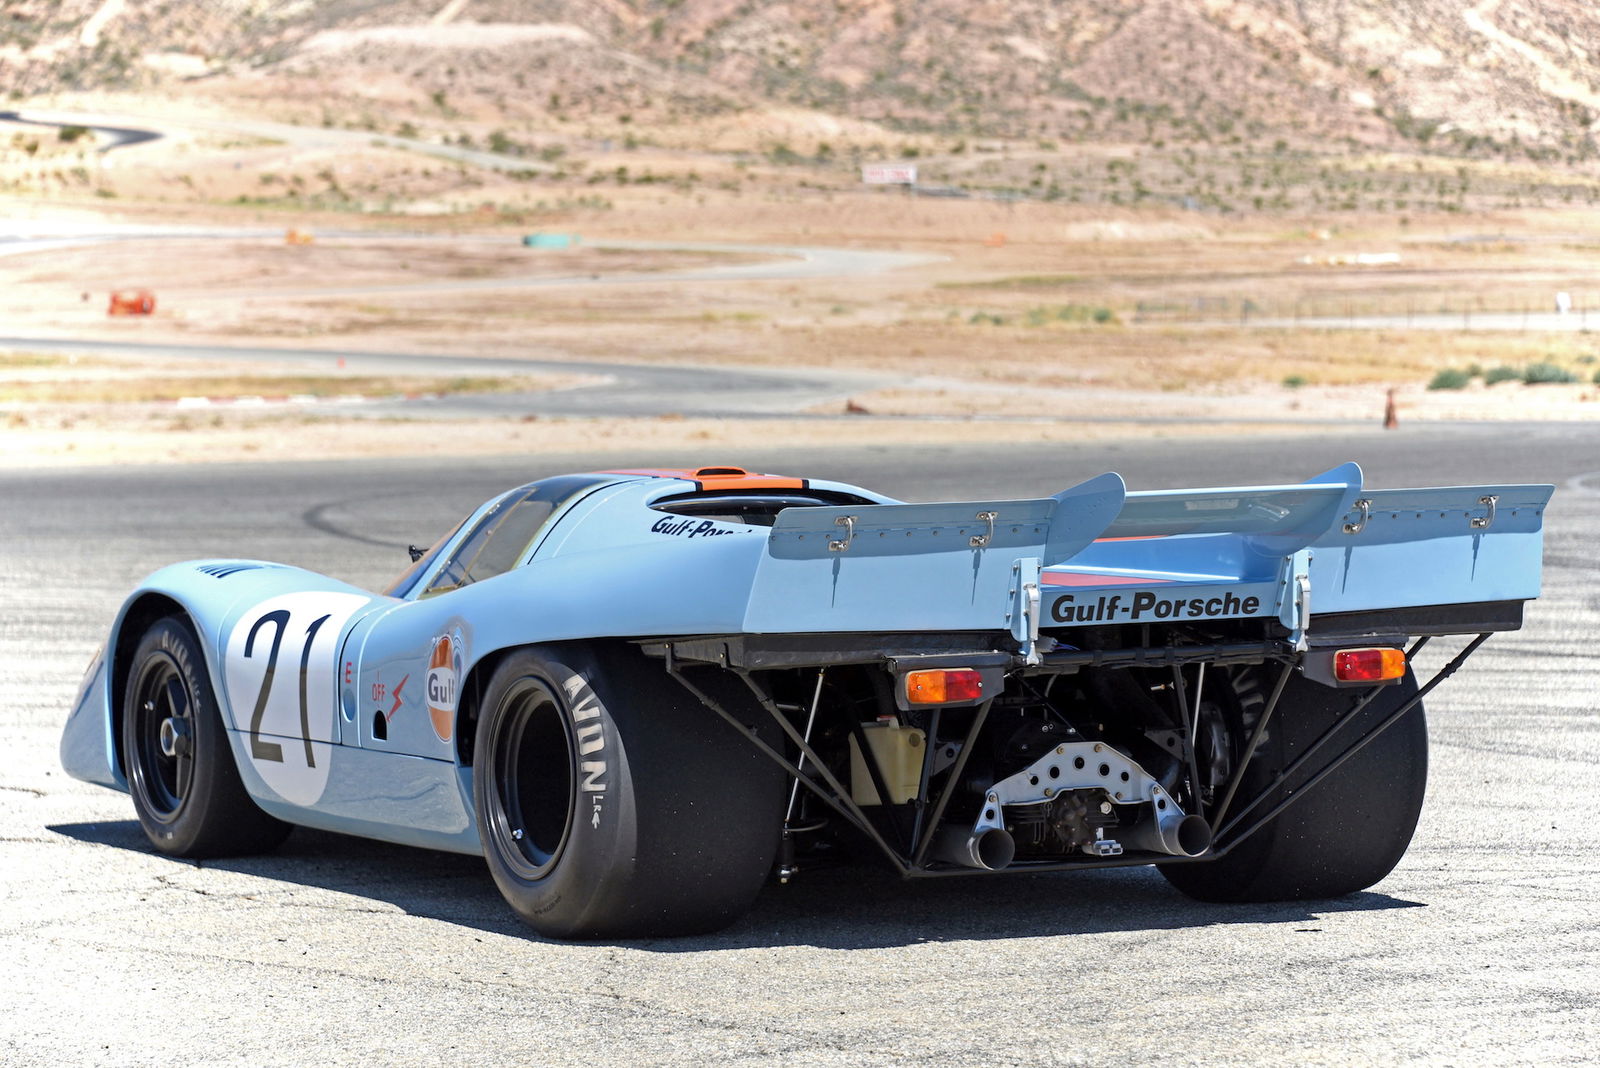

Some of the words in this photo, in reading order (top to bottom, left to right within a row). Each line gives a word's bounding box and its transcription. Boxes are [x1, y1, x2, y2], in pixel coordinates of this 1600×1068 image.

[651, 515, 753, 538] Gulf-Por
[1051, 592, 1260, 623] Gulf-Porsche
[345, 662, 352, 683] E
[244, 610, 332, 769] 21
[372, 683, 385, 702] OFF
[562, 673, 608, 793] AVON
[592, 795, 604, 813] LR
